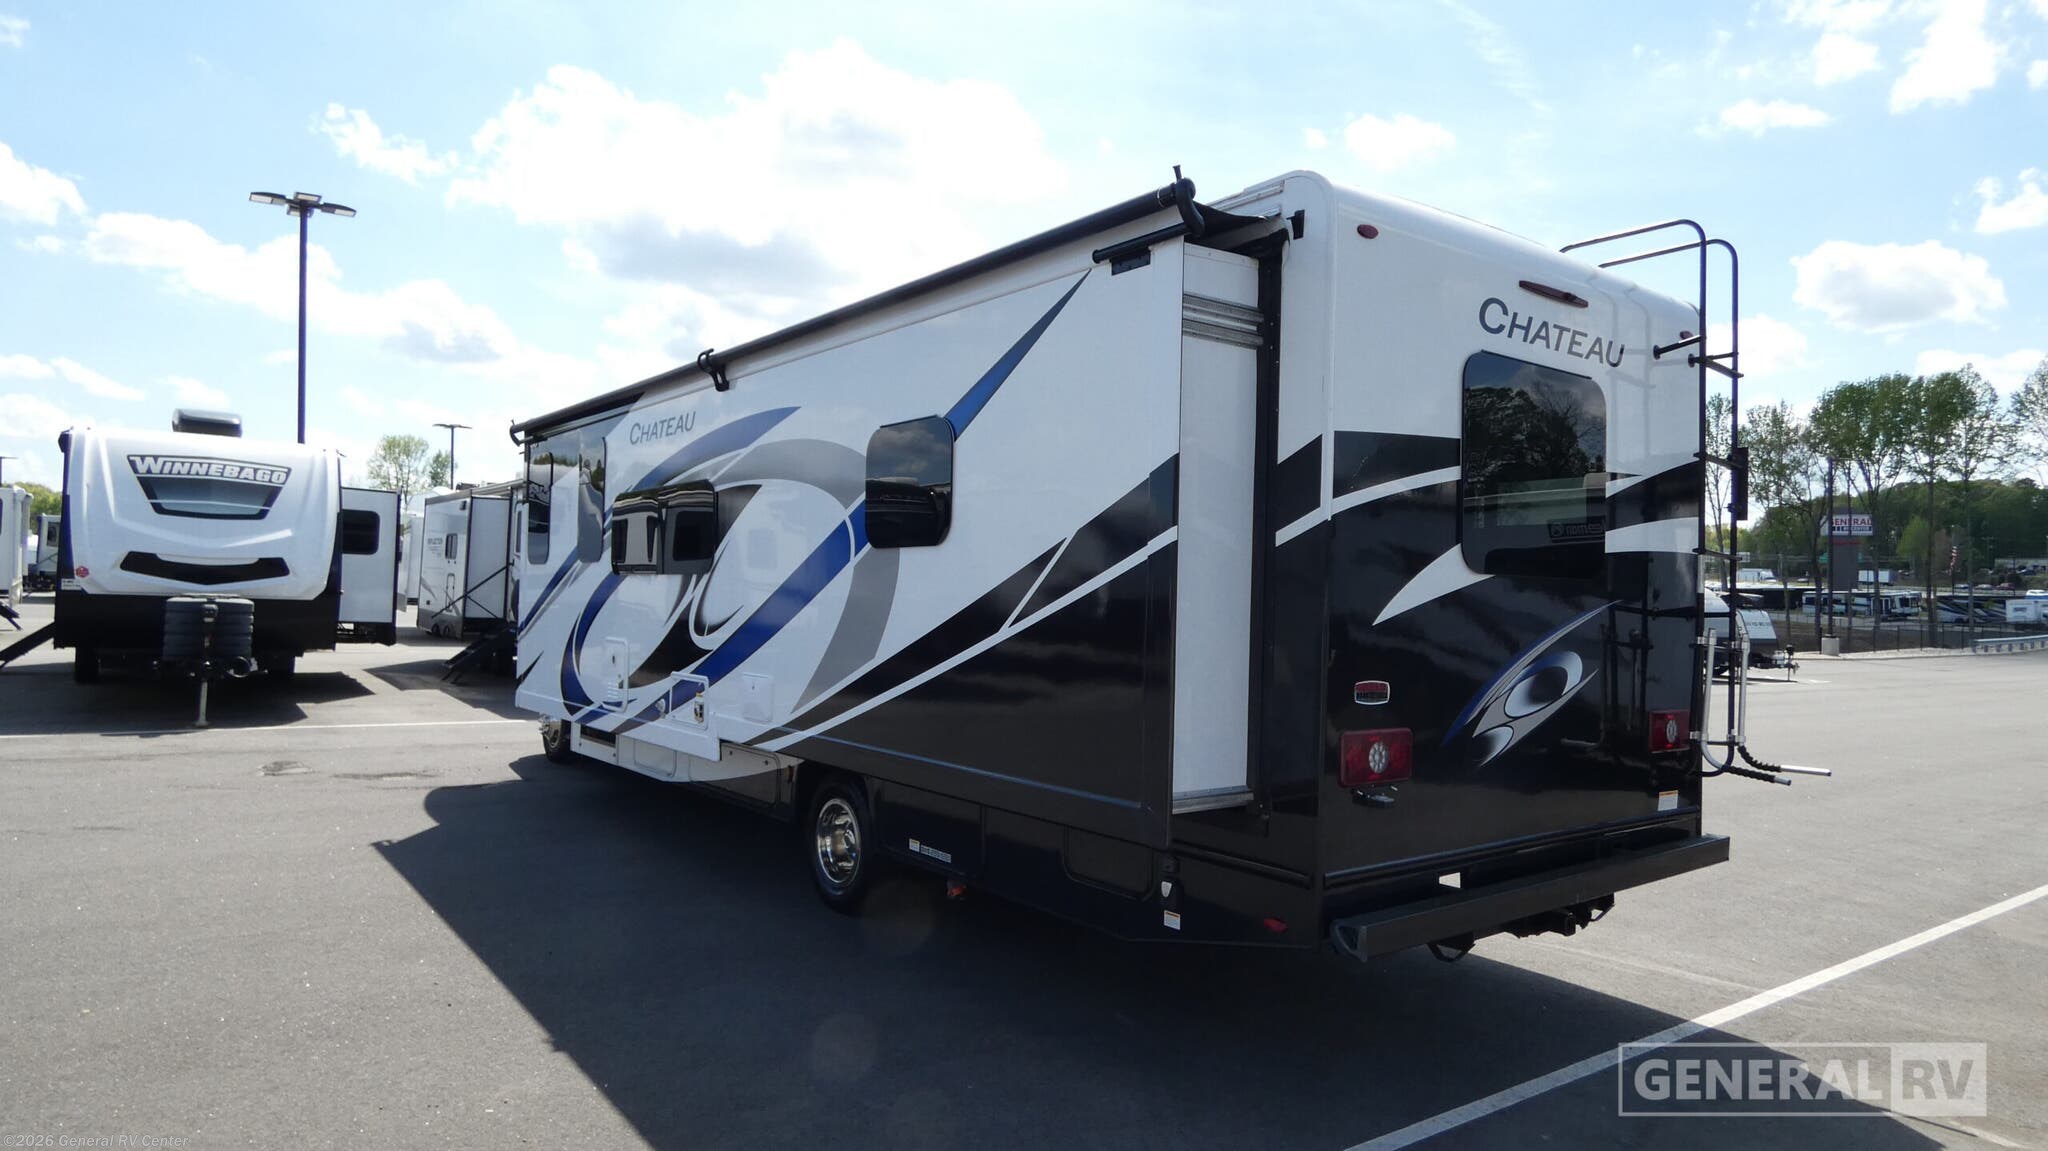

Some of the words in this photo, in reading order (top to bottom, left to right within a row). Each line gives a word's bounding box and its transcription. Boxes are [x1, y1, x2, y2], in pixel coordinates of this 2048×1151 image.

[1478, 297, 1625, 367] CHATEAU
[629, 411, 696, 445] CHATEAU
[129, 456, 287, 484] WINNEBAGO
